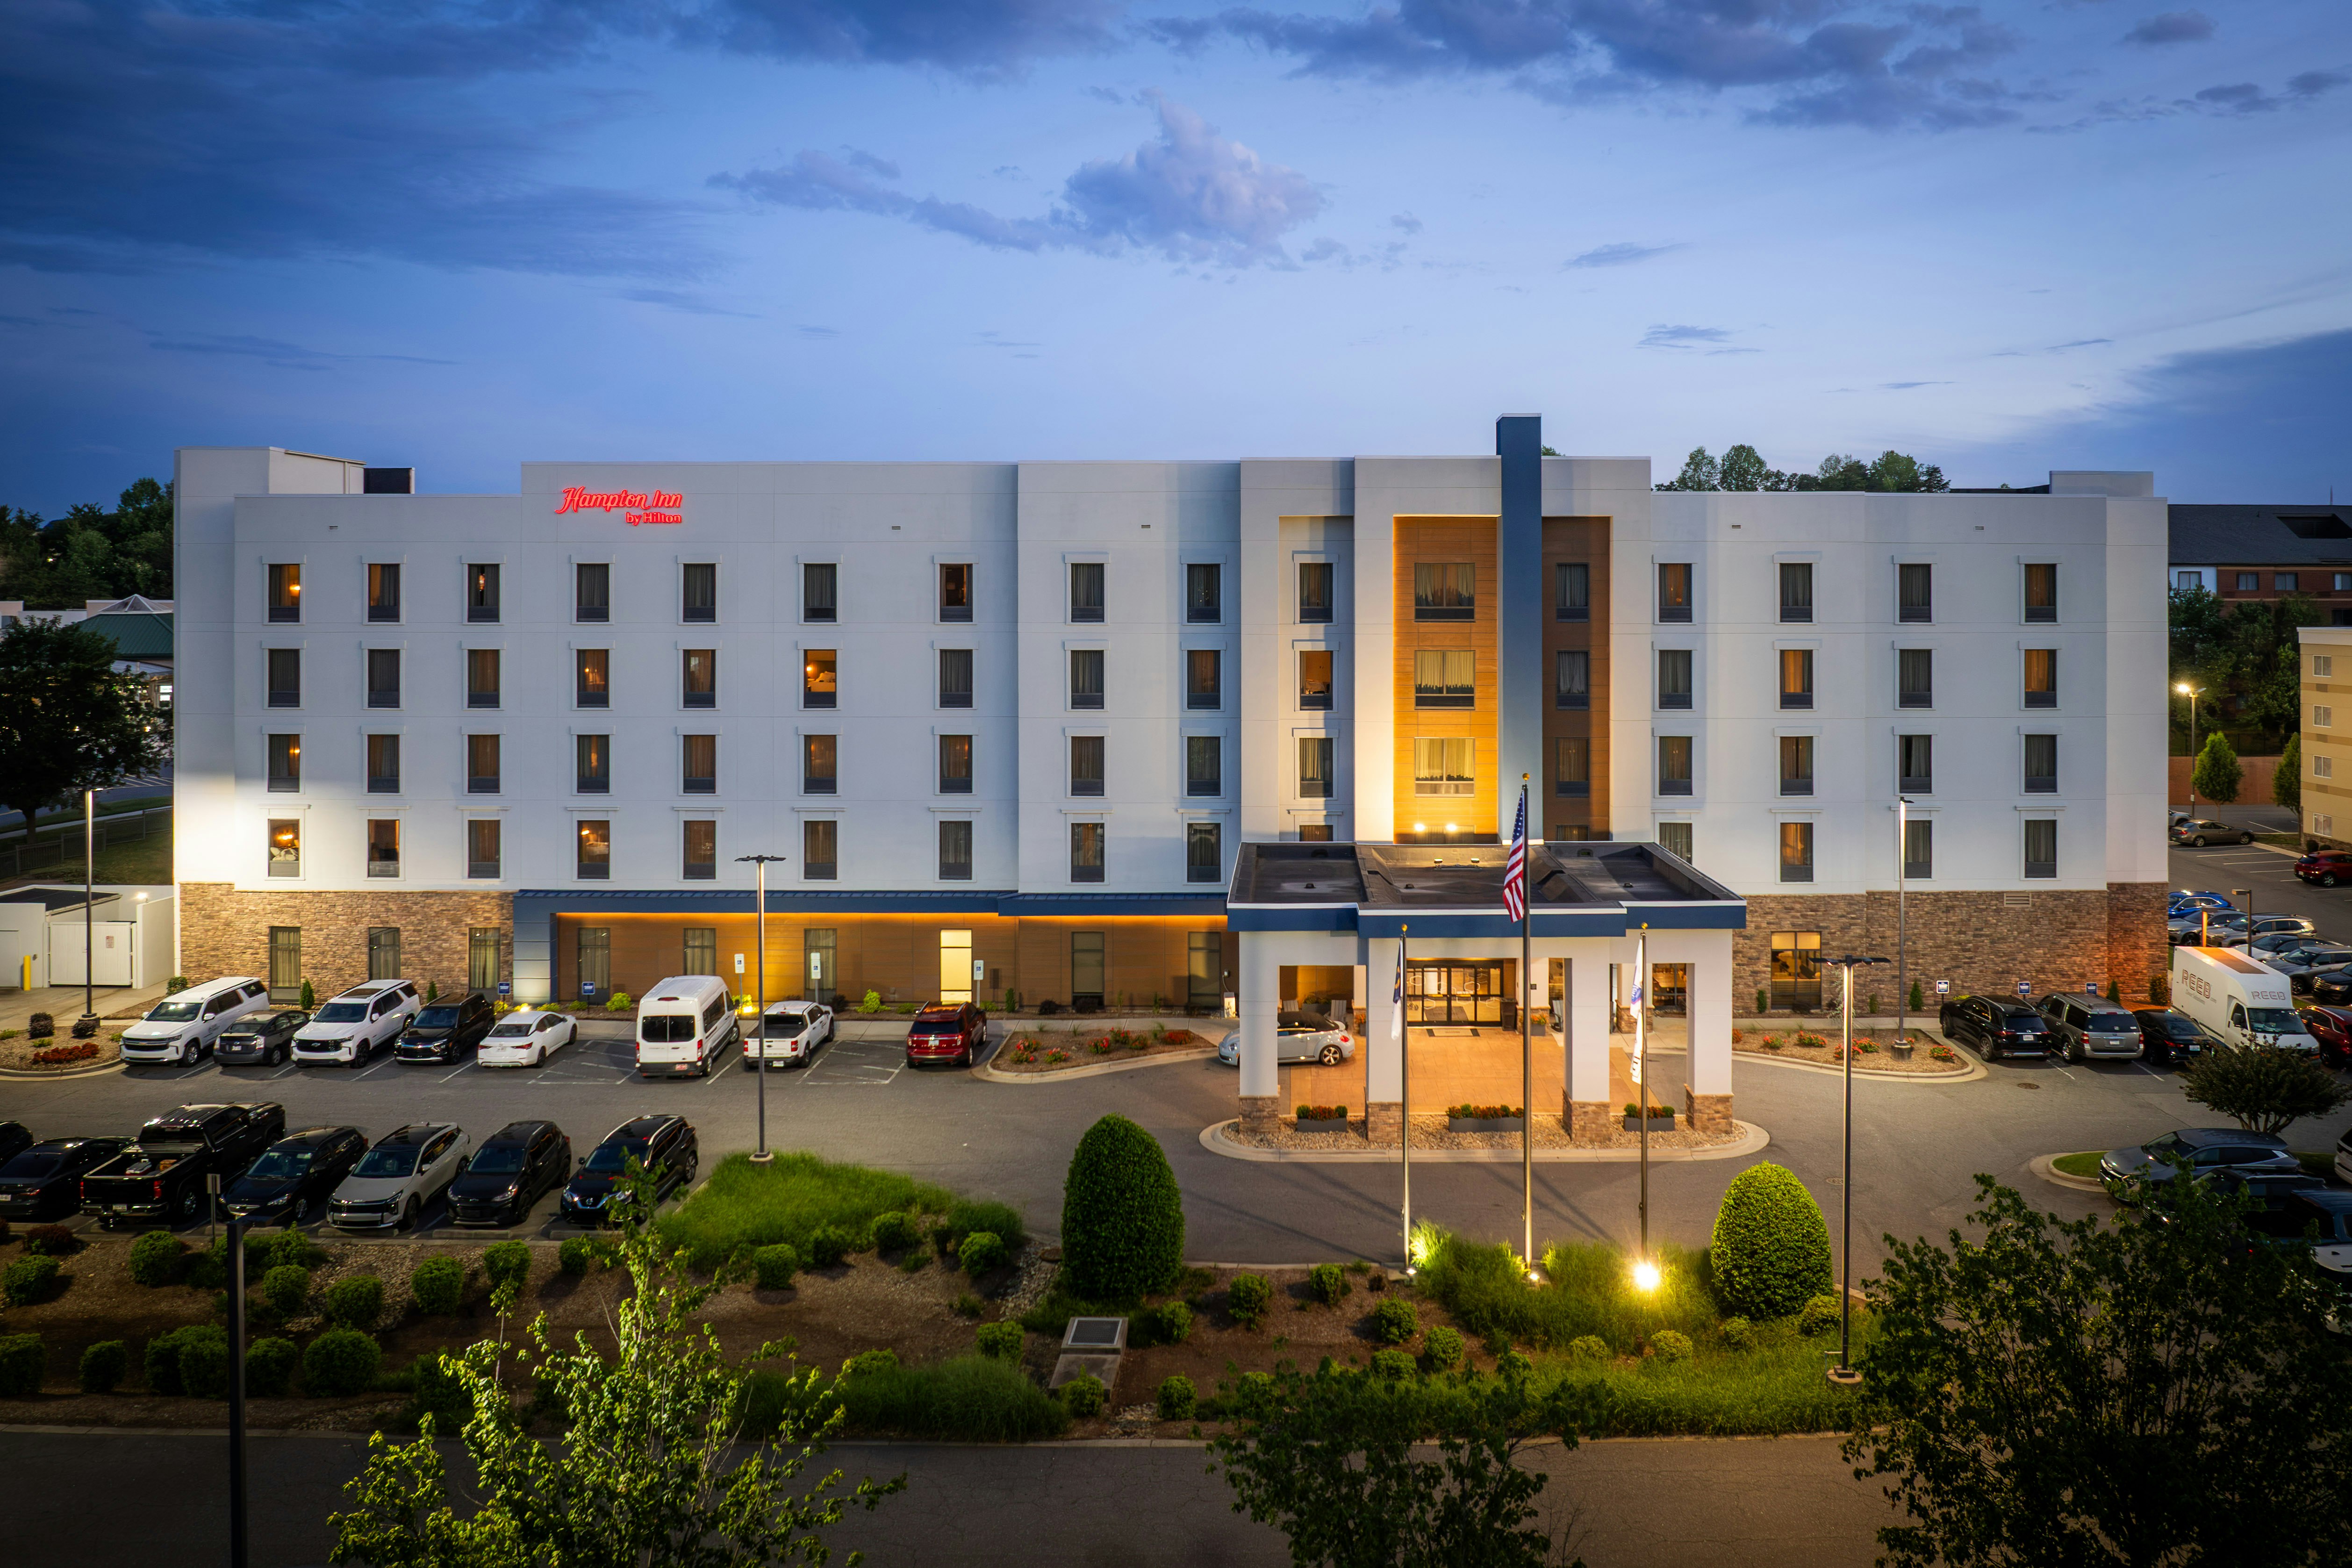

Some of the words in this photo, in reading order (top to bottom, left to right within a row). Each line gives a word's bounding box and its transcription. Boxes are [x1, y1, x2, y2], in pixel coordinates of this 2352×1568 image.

[555, 487, 650, 513] Hampton
[652, 490, 682, 508] Inn
[625, 512, 642, 526] by
[642, 512, 682, 523] Hilton
[2182, 969, 2210, 999] REEB
[2251, 991, 2286, 1000] REEB
